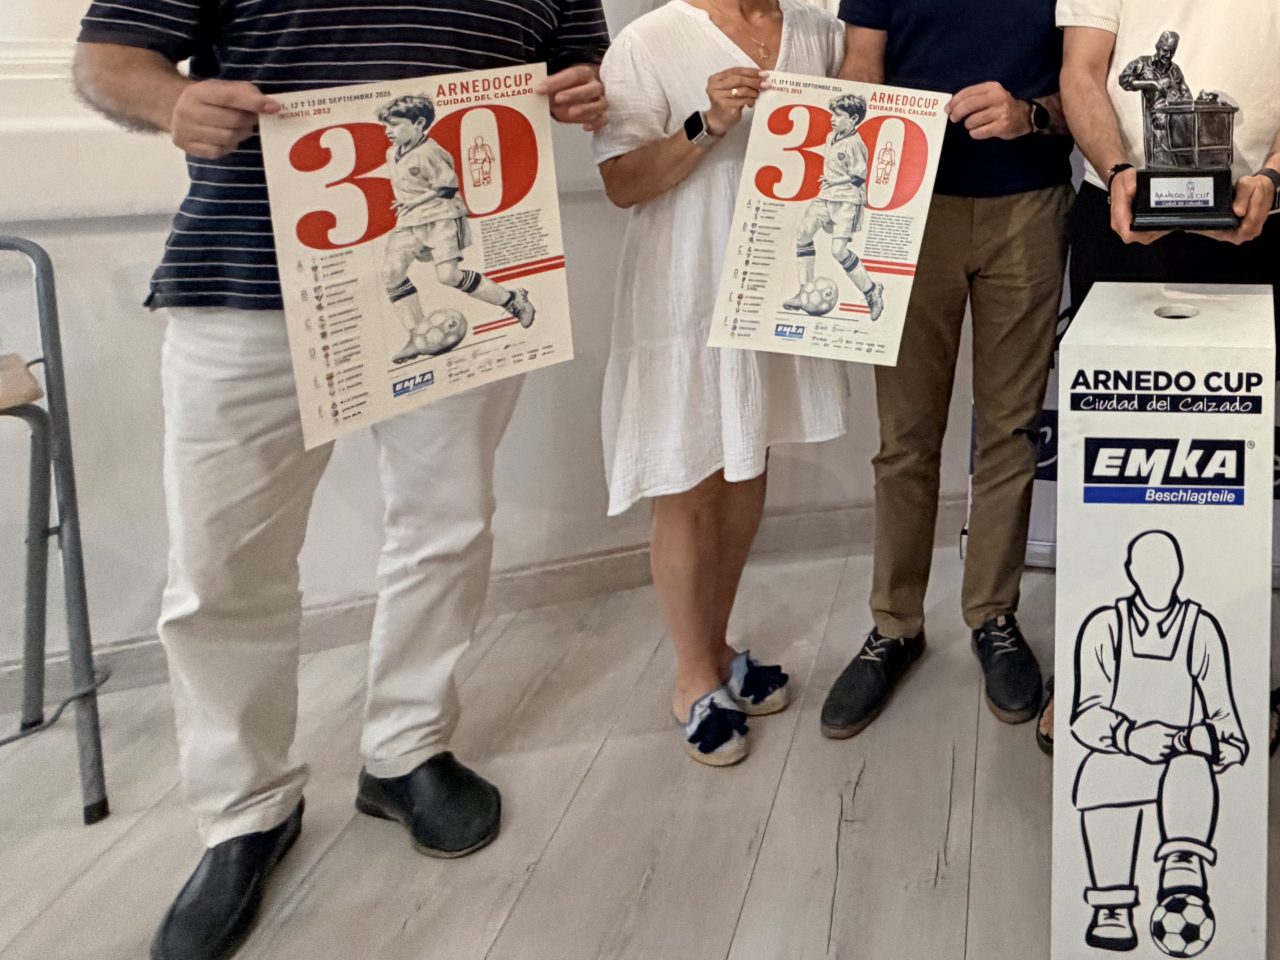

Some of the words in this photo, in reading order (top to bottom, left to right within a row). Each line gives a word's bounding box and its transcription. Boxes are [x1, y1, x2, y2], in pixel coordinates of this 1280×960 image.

[436, 73, 533, 97] ARNEDOCUP
[802, 82, 830, 90] SEPTIEMBRE
[328, 93, 373, 105] SEPTIEMBRE
[436, 96, 472, 106] CUIDAD
[474, 94, 492, 102] DEL
[494, 88, 533, 99] CALZADO
[870, 92, 939, 109] ARNEDOCUP
[869, 104, 893, 112] CUIDAD
[908, 109, 937, 117] CALZADO
[754, 104, 929, 212] 30
[288, 104, 538, 250] 30
[1070, 369, 1196, 391] ARNEDO
[1204, 371, 1263, 393] CUP
[1080, 394, 1138, 410] Ciudad
[1147, 395, 1170, 410] del
[1179, 397, 1252, 413] Calzado
[1092, 440, 1237, 485] EMKA
[1145, 490, 1235, 504] Beschlagteile
